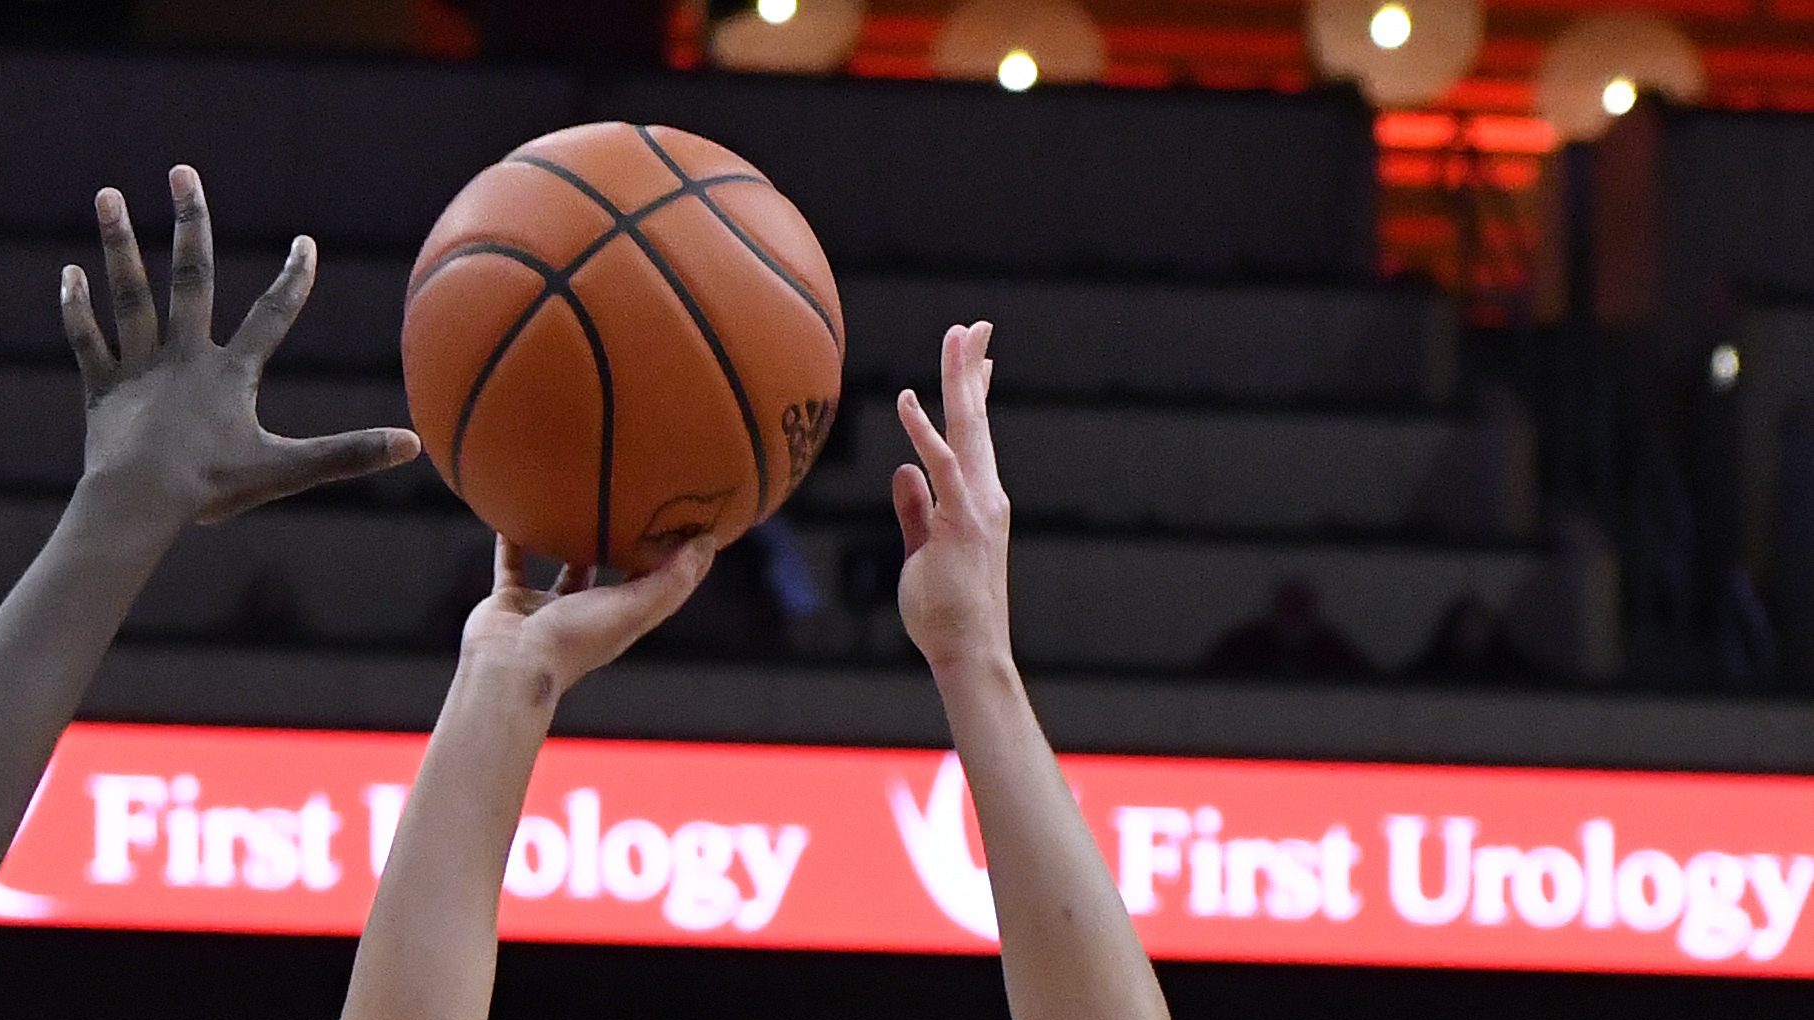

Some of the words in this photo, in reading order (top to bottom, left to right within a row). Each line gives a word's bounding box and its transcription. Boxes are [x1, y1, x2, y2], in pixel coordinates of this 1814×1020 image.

[88, 773, 340, 891] First
[364, 783, 807, 932] ology
[1112, 805, 1362, 921] First
[1384, 813, 1814, 961] Urology
